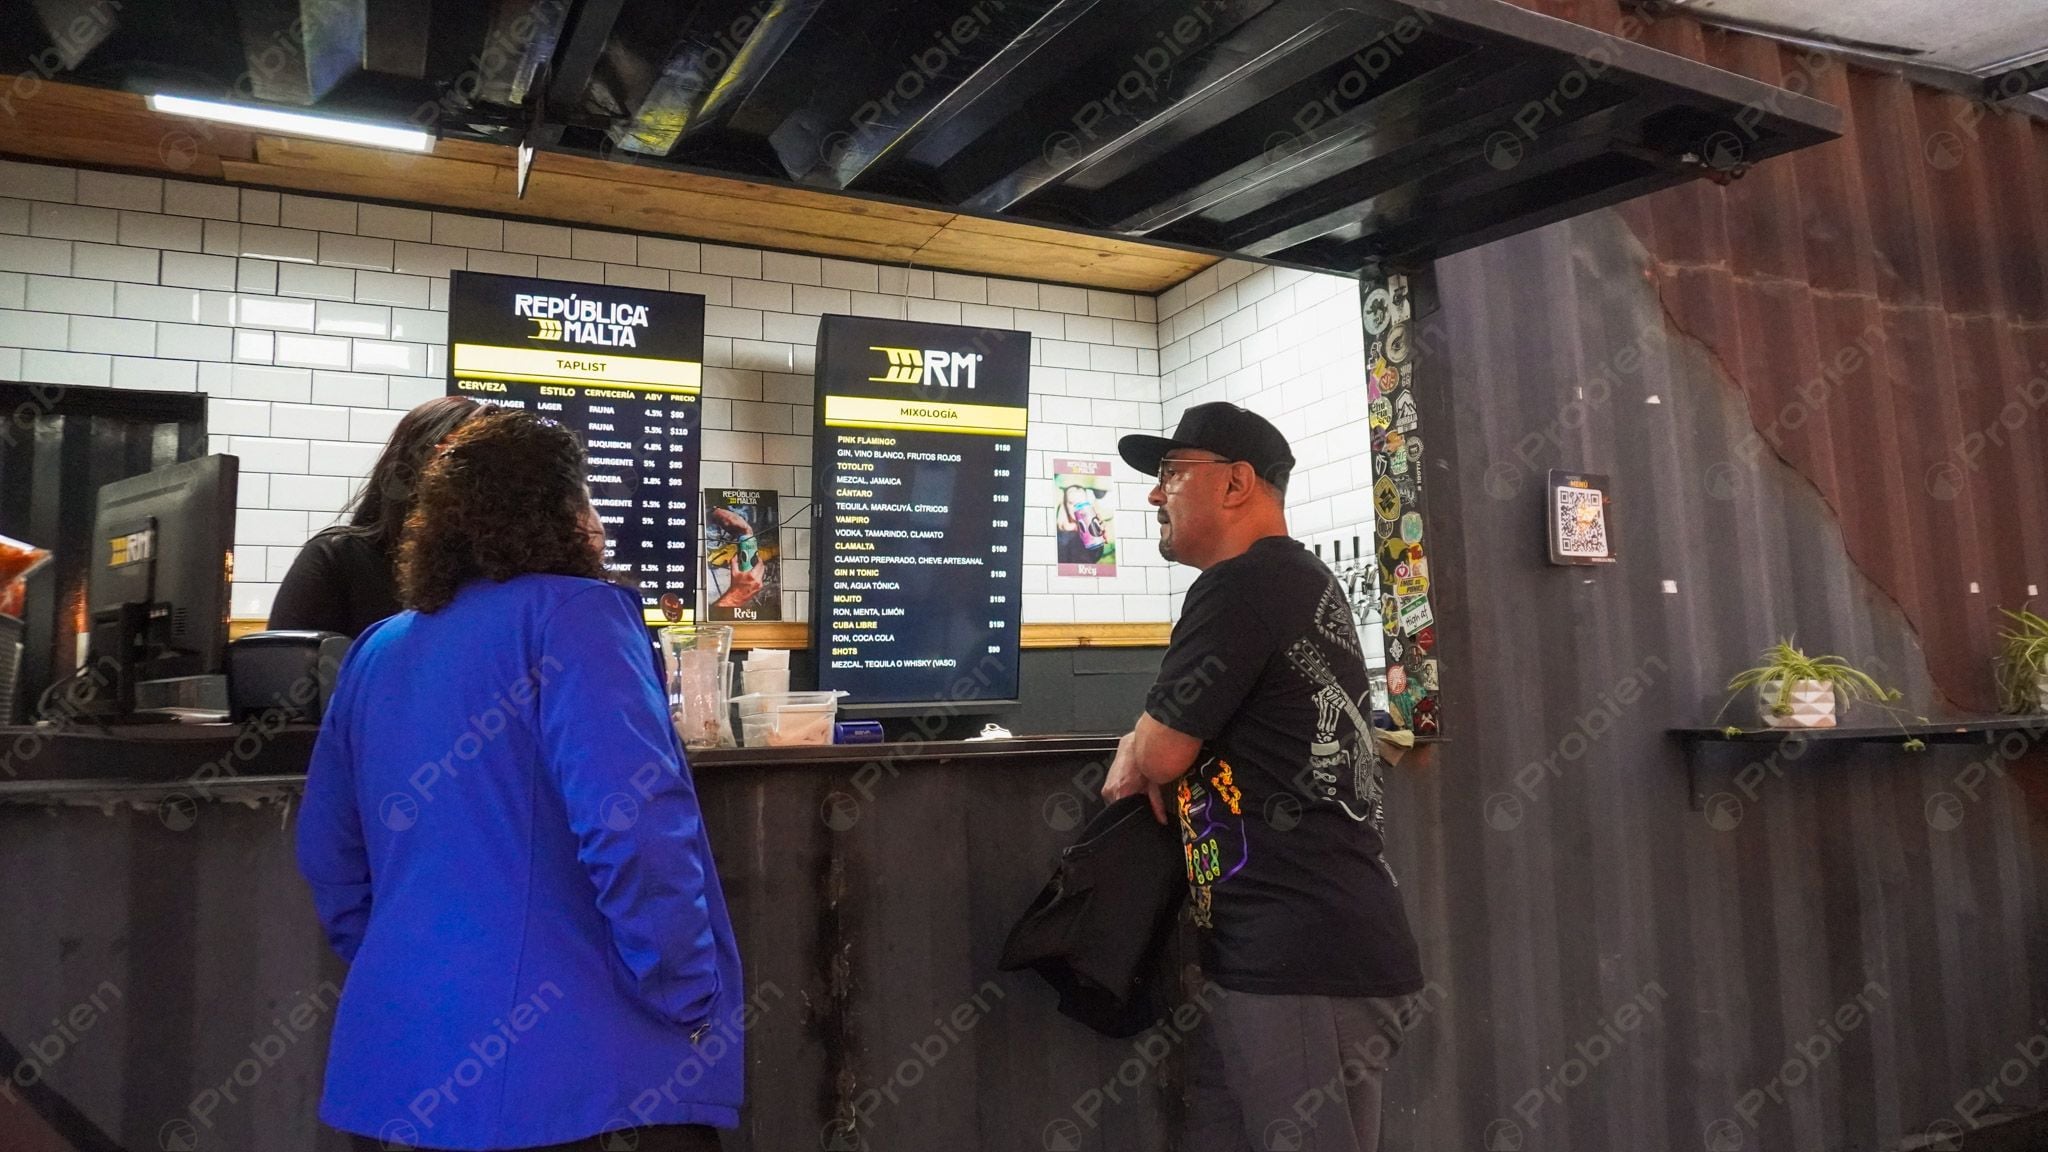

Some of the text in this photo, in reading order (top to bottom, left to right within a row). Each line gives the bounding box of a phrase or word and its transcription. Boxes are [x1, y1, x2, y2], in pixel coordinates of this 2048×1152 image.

[515, 294, 648, 327] REPÚBLICA
[564, 321, 636, 347] MALTA
[557, 359, 606, 372] TAPLIST
[923, 350, 976, 388] RM
[458, 380, 507, 393] CERVEZA
[540, 386, 576, 397] ESTILO
[585, 388, 635, 400] CERVECERÍA
[645, 393, 662, 401] ABV
[500, 400, 524, 409] LAGER
[538, 402, 562, 411] LAGER
[589, 406, 614, 414] FAUNA
[900, 407, 958, 419] MIXOLOGÍA
[589, 423, 614, 431] FAUNA
[670, 428, 688, 436] $110
[838, 436, 896, 446] PINK FLAMINGO
[854, 450, 872, 458] VINO
[907, 452, 936, 461] FRUTOS
[937, 454, 961, 462] ROJOS
[588, 458, 633, 466] INSURGENTE
[837, 462, 874, 471] TOTOLITO
[870, 477, 901, 485] JAMAICA
[723, 490, 760, 498] REPÚBLICA
[837, 488, 872, 498] CÁNTARO
[589, 499, 632, 507] NSURGENTE
[915, 504, 948, 513] CÍTRICOS
[668, 518, 686, 526] $100
[836, 515, 870, 524] VAMPIRO
[865, 530, 909, 538] TAMARINDO,
[910, 530, 943, 539] CLAMATO
[667, 541, 685, 549] $100
[835, 542, 875, 550] CLAMALTA
[835, 556, 984, 566] CLAMATO PREPARADO, CHEVE ARTESANAL
[666, 564, 684, 572] $100
[834, 569, 879, 577] GIN N TONIC
[666, 581, 684, 589] $100
[850, 582, 872, 590] AGUA
[873, 581, 900, 590] TÓNICA
[834, 595, 862, 603] MOJITO
[882, 607, 905, 616] LIMÓN
[833, 621, 878, 629] CUBA LIBRE
[865, 660, 895, 668] TEQUILA
[896, 660, 902, 668] O
[904, 660, 931, 668] WHISKY
[932, 659, 956, 668] (VASO)
